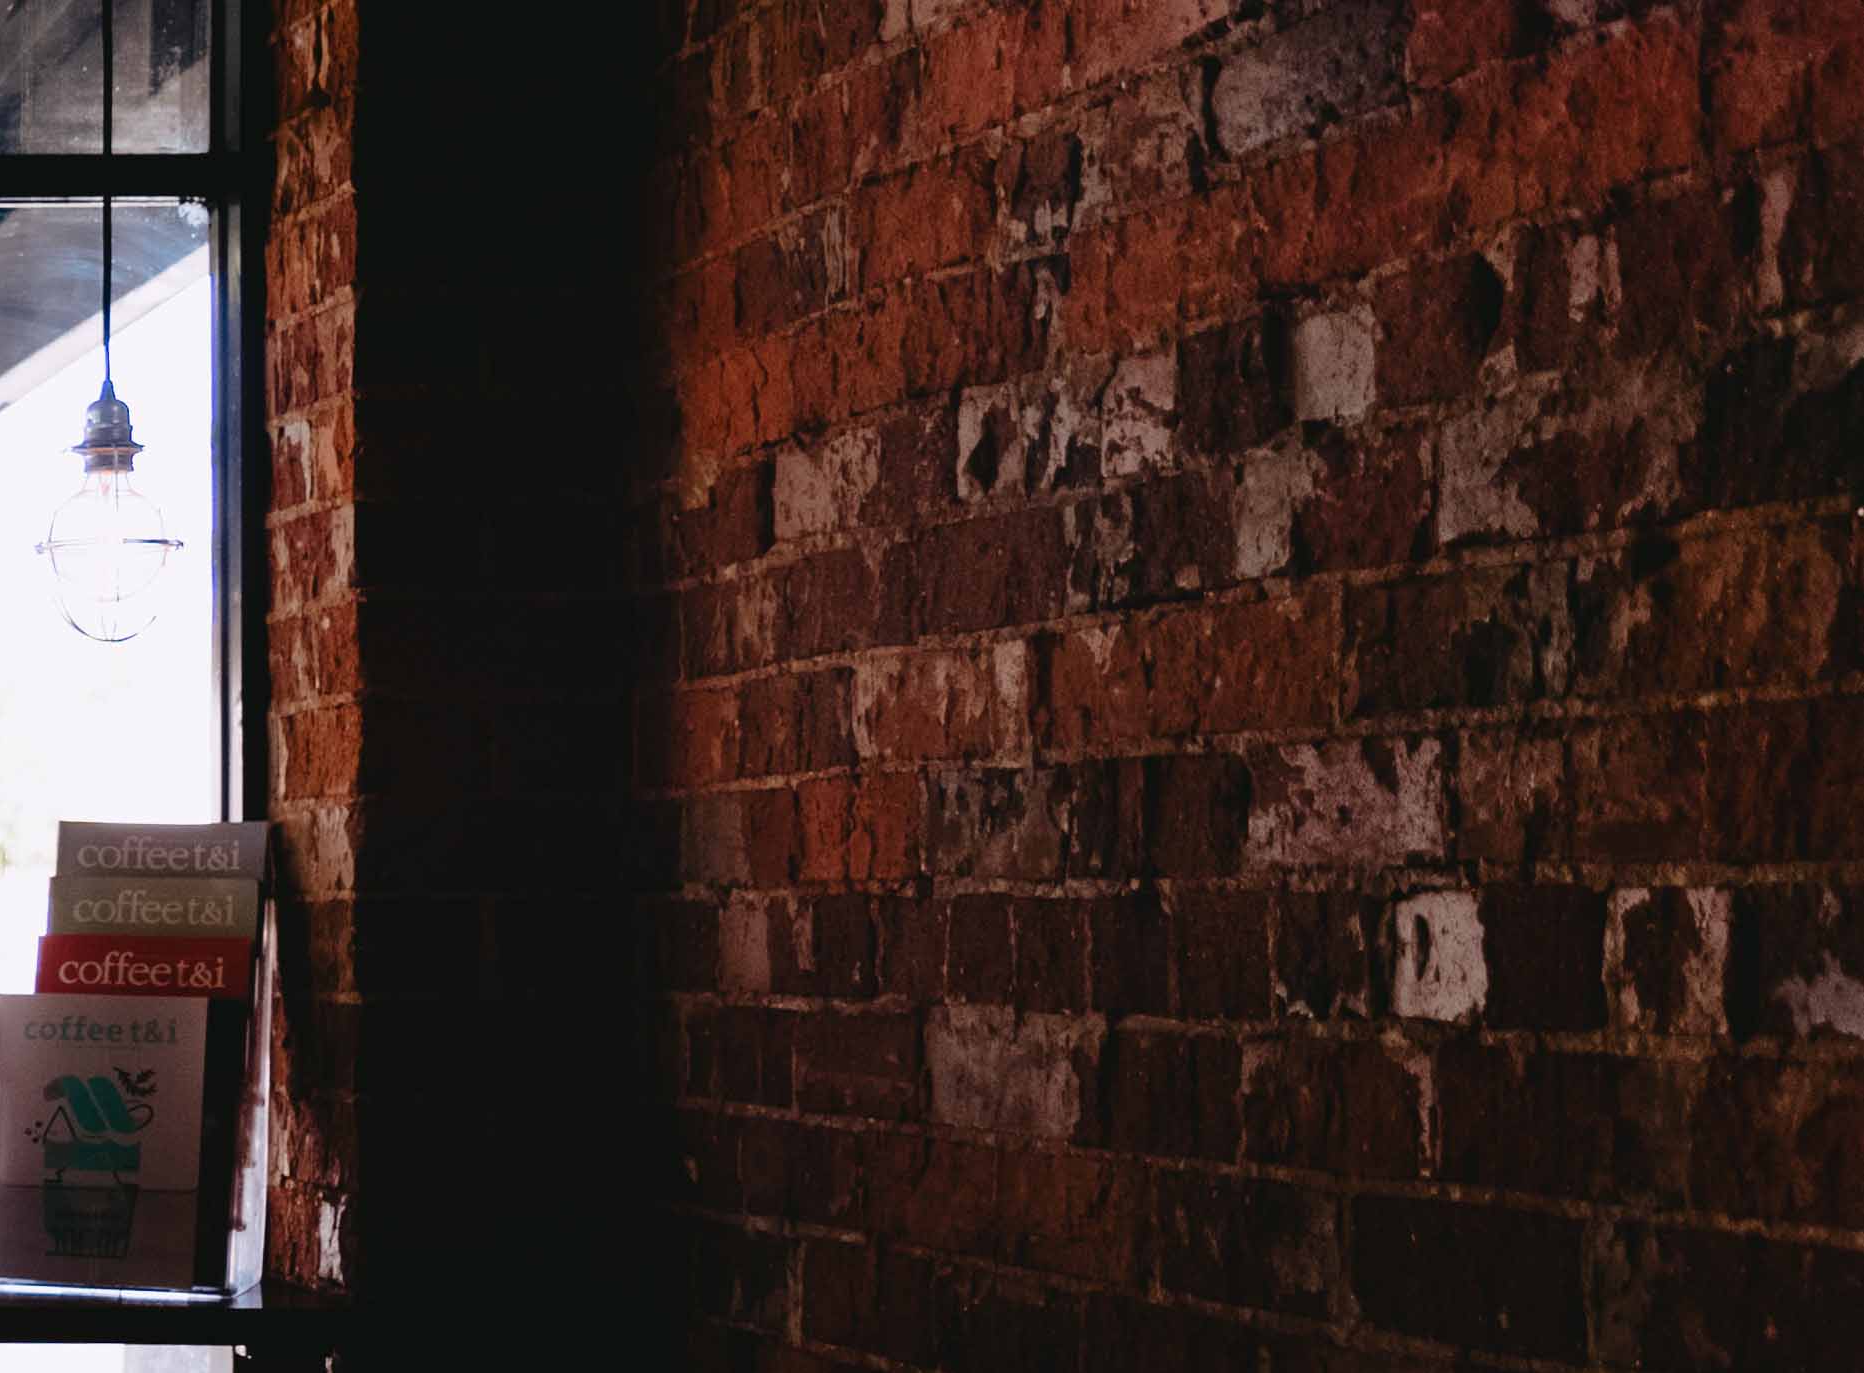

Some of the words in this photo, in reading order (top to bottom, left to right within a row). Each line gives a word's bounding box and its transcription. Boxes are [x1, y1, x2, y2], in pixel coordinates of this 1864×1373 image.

[77, 836, 190, 870] coffee
[73, 889, 183, 925] coffee
[188, 895, 236, 927] t&i
[59, 951, 173, 986] coffee
[176, 957, 227, 989] t&i
[24, 1015, 124, 1043] coffee
